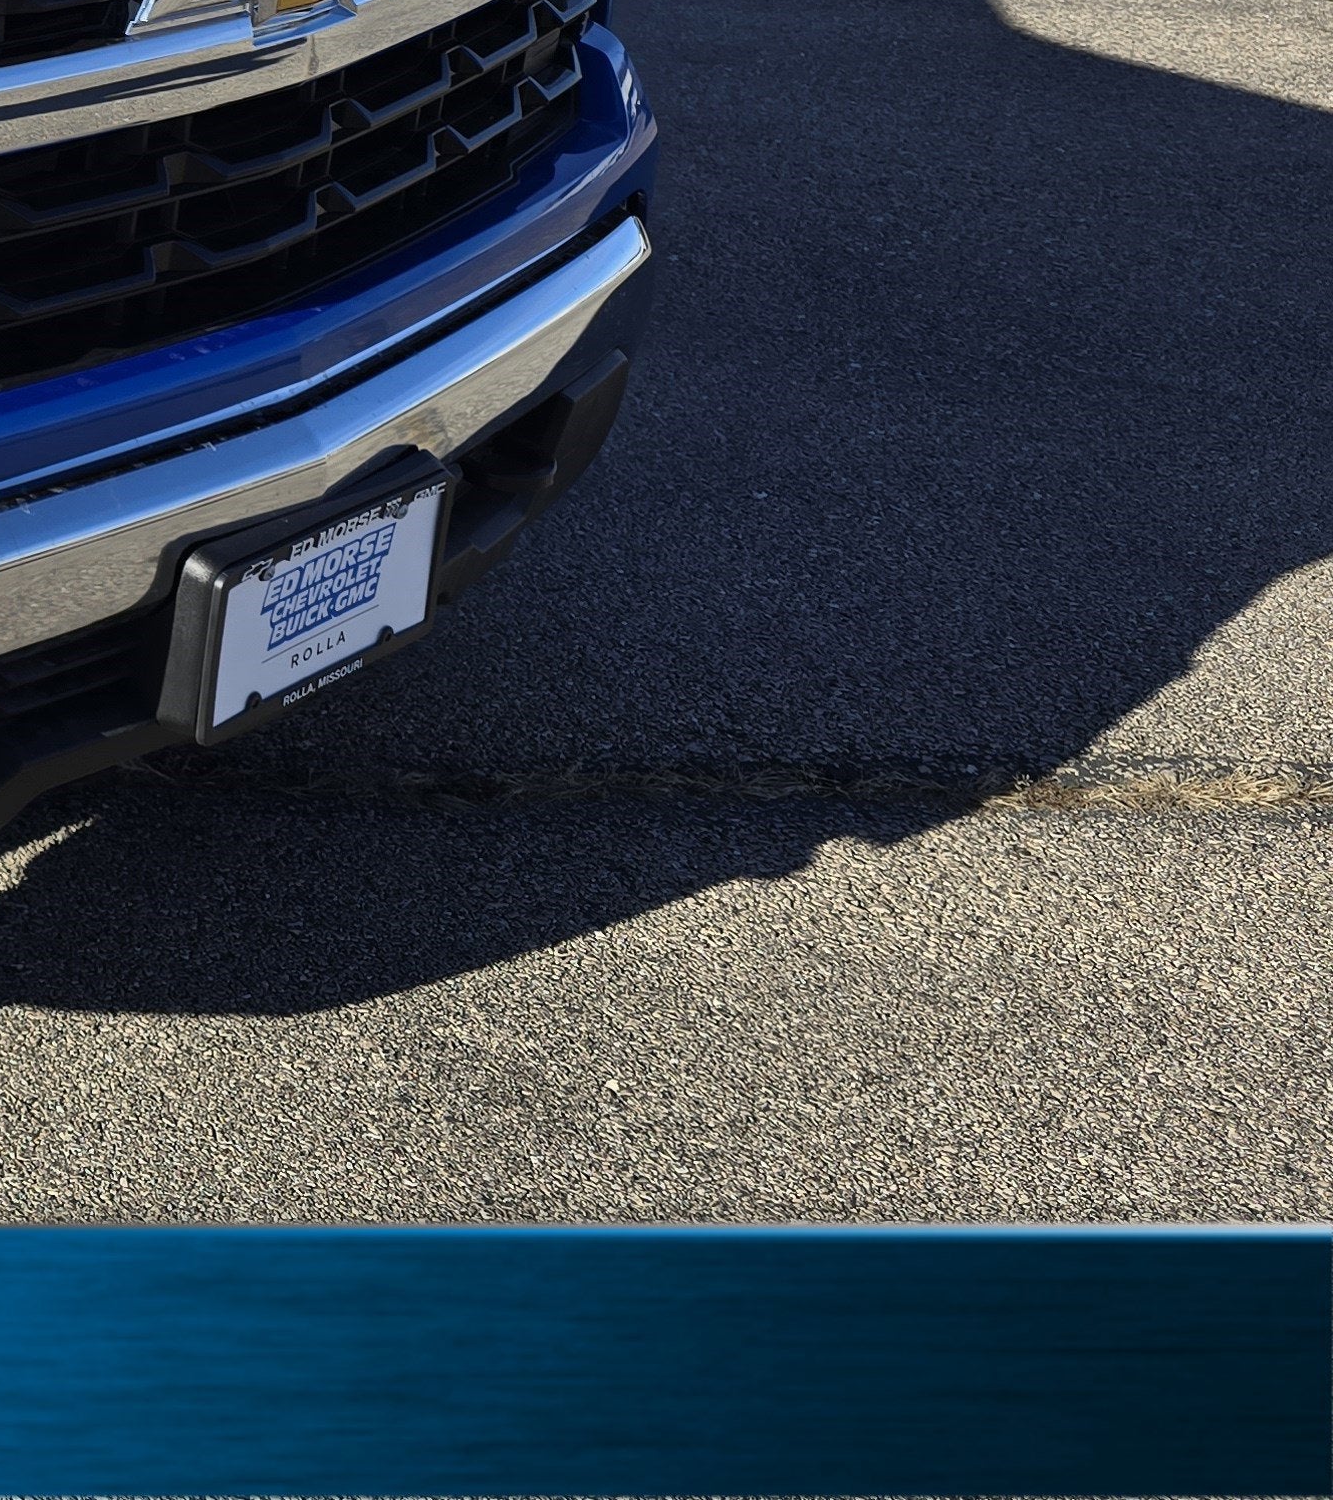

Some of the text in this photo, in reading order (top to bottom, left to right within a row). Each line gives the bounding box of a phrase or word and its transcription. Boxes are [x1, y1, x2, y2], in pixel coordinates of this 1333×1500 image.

[290, 536, 315, 558] ED
[317, 505, 382, 548] MORSE
[263, 528, 395, 608] ED MORSE
[291, 631, 346, 668] ROLLA
[283, 658, 364, 706] ROLLA, MISSOURI
